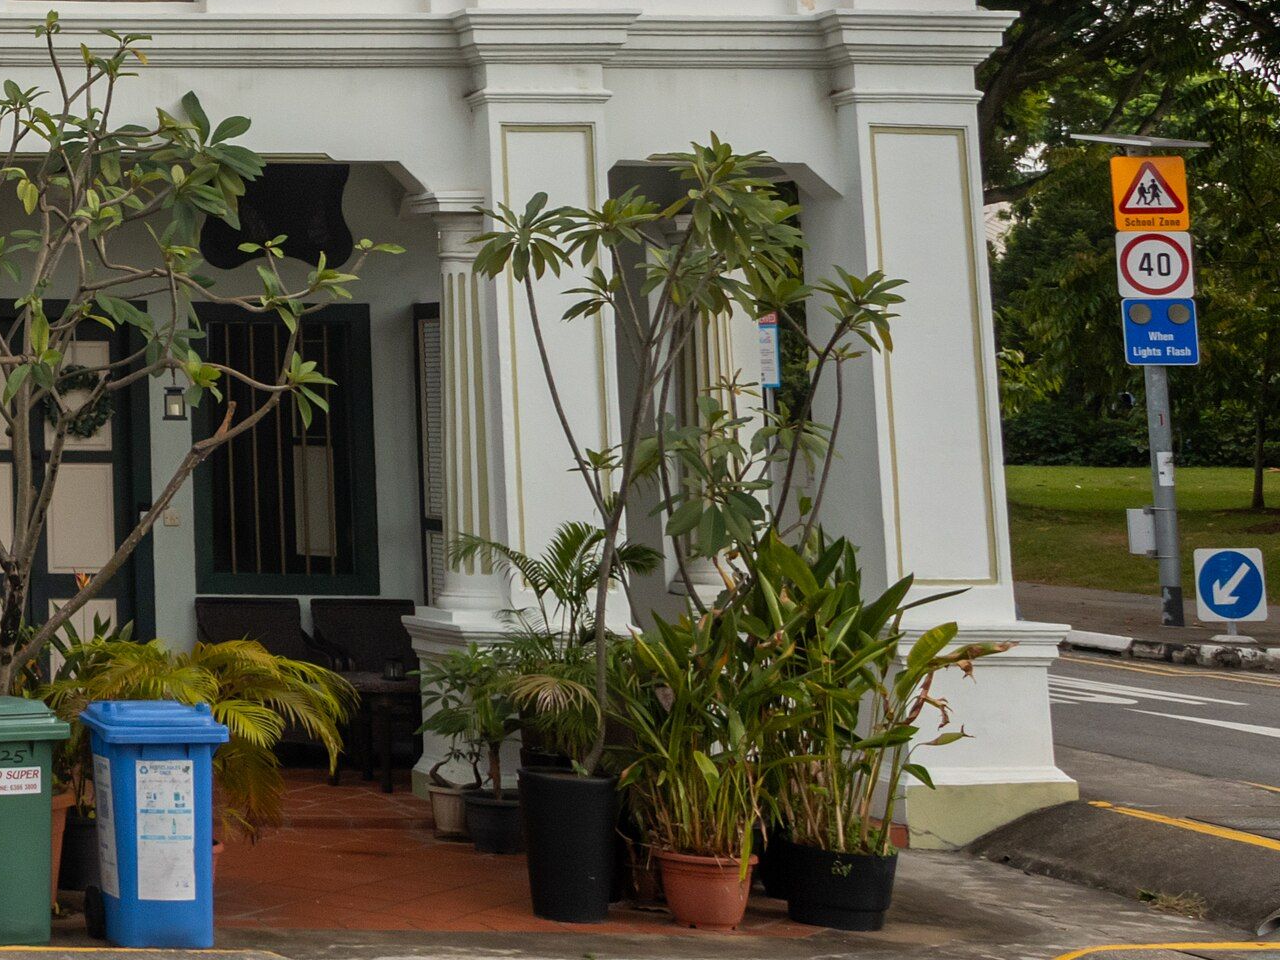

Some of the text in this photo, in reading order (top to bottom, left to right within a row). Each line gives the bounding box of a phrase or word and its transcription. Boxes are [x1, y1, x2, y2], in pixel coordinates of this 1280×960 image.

[1124, 217, 1181, 227] School Zone
[1138, 252, 1171, 277] 40
[1148, 331, 1174, 341] When
[1132, 346, 1192, 359] Lights Flash
[0, 749, 27, 764] 25
[5, 769, 40, 780] SUPER
